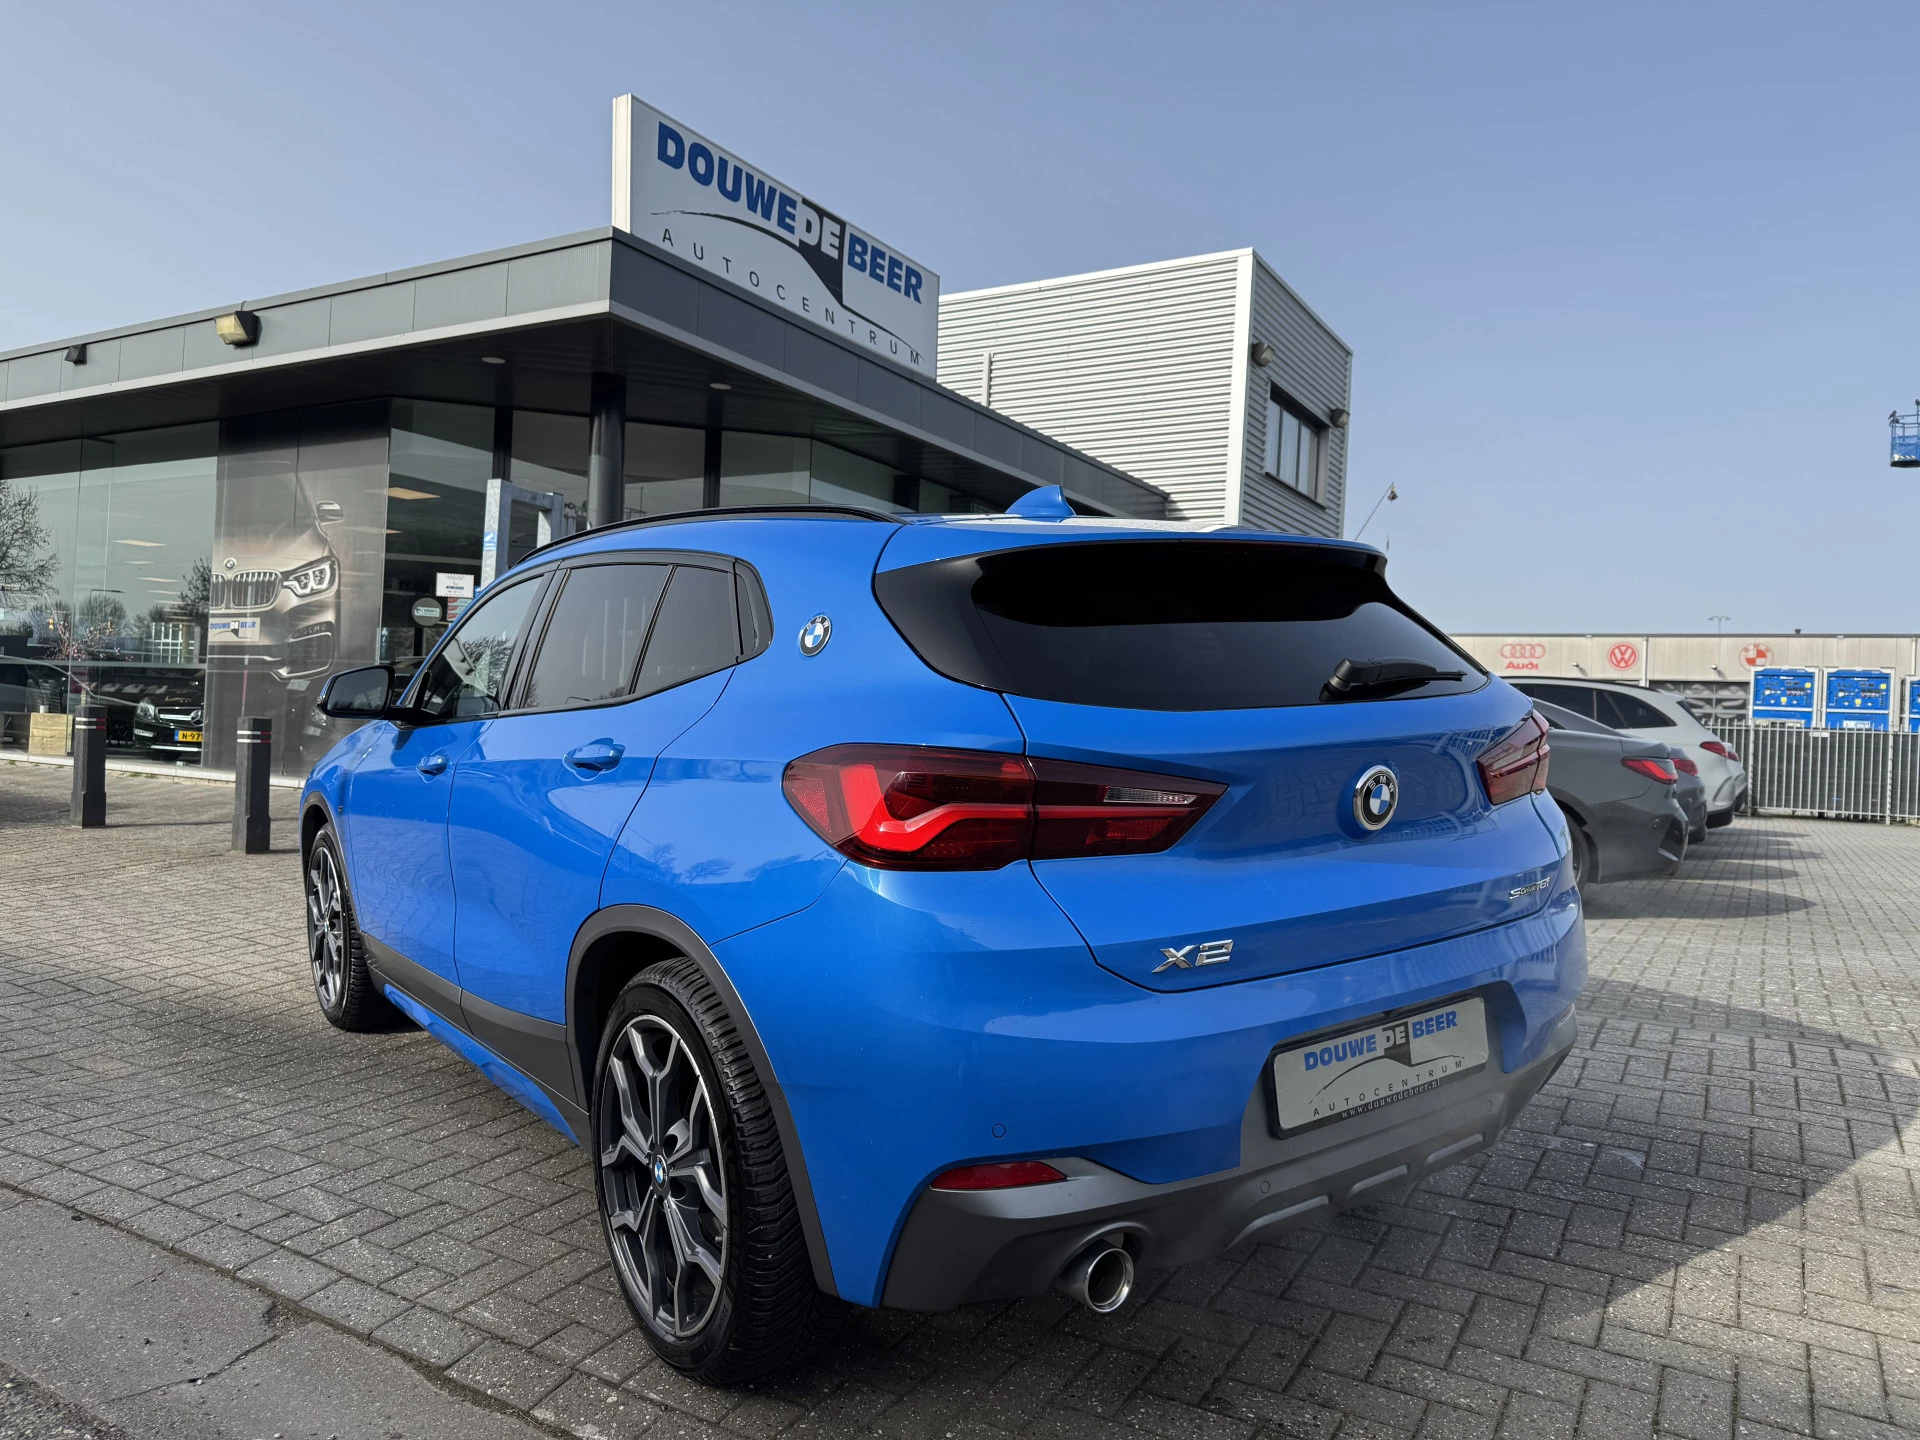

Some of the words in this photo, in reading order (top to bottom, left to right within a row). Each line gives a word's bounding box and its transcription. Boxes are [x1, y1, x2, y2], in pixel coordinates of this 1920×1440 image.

[657, 121, 797, 235] DOUWE
[799, 203, 841, 260] DE
[847, 232, 923, 304] BEER
[662, 228, 920, 366] AUTOCENTRUM
[240, 621, 256, 629] BEER
[1504, 660, 1539, 670] Audi
[1151, 939, 1234, 974] X2
[1303, 1033, 1377, 1072] DOUWE
[1383, 1026, 1406, 1049] DE
[1411, 1010, 1458, 1040] BEER
[1313, 1060, 1462, 1117] AUTOCENTRUM
[1341, 1078, 1441, 1119] www.douwedebeer.nl
